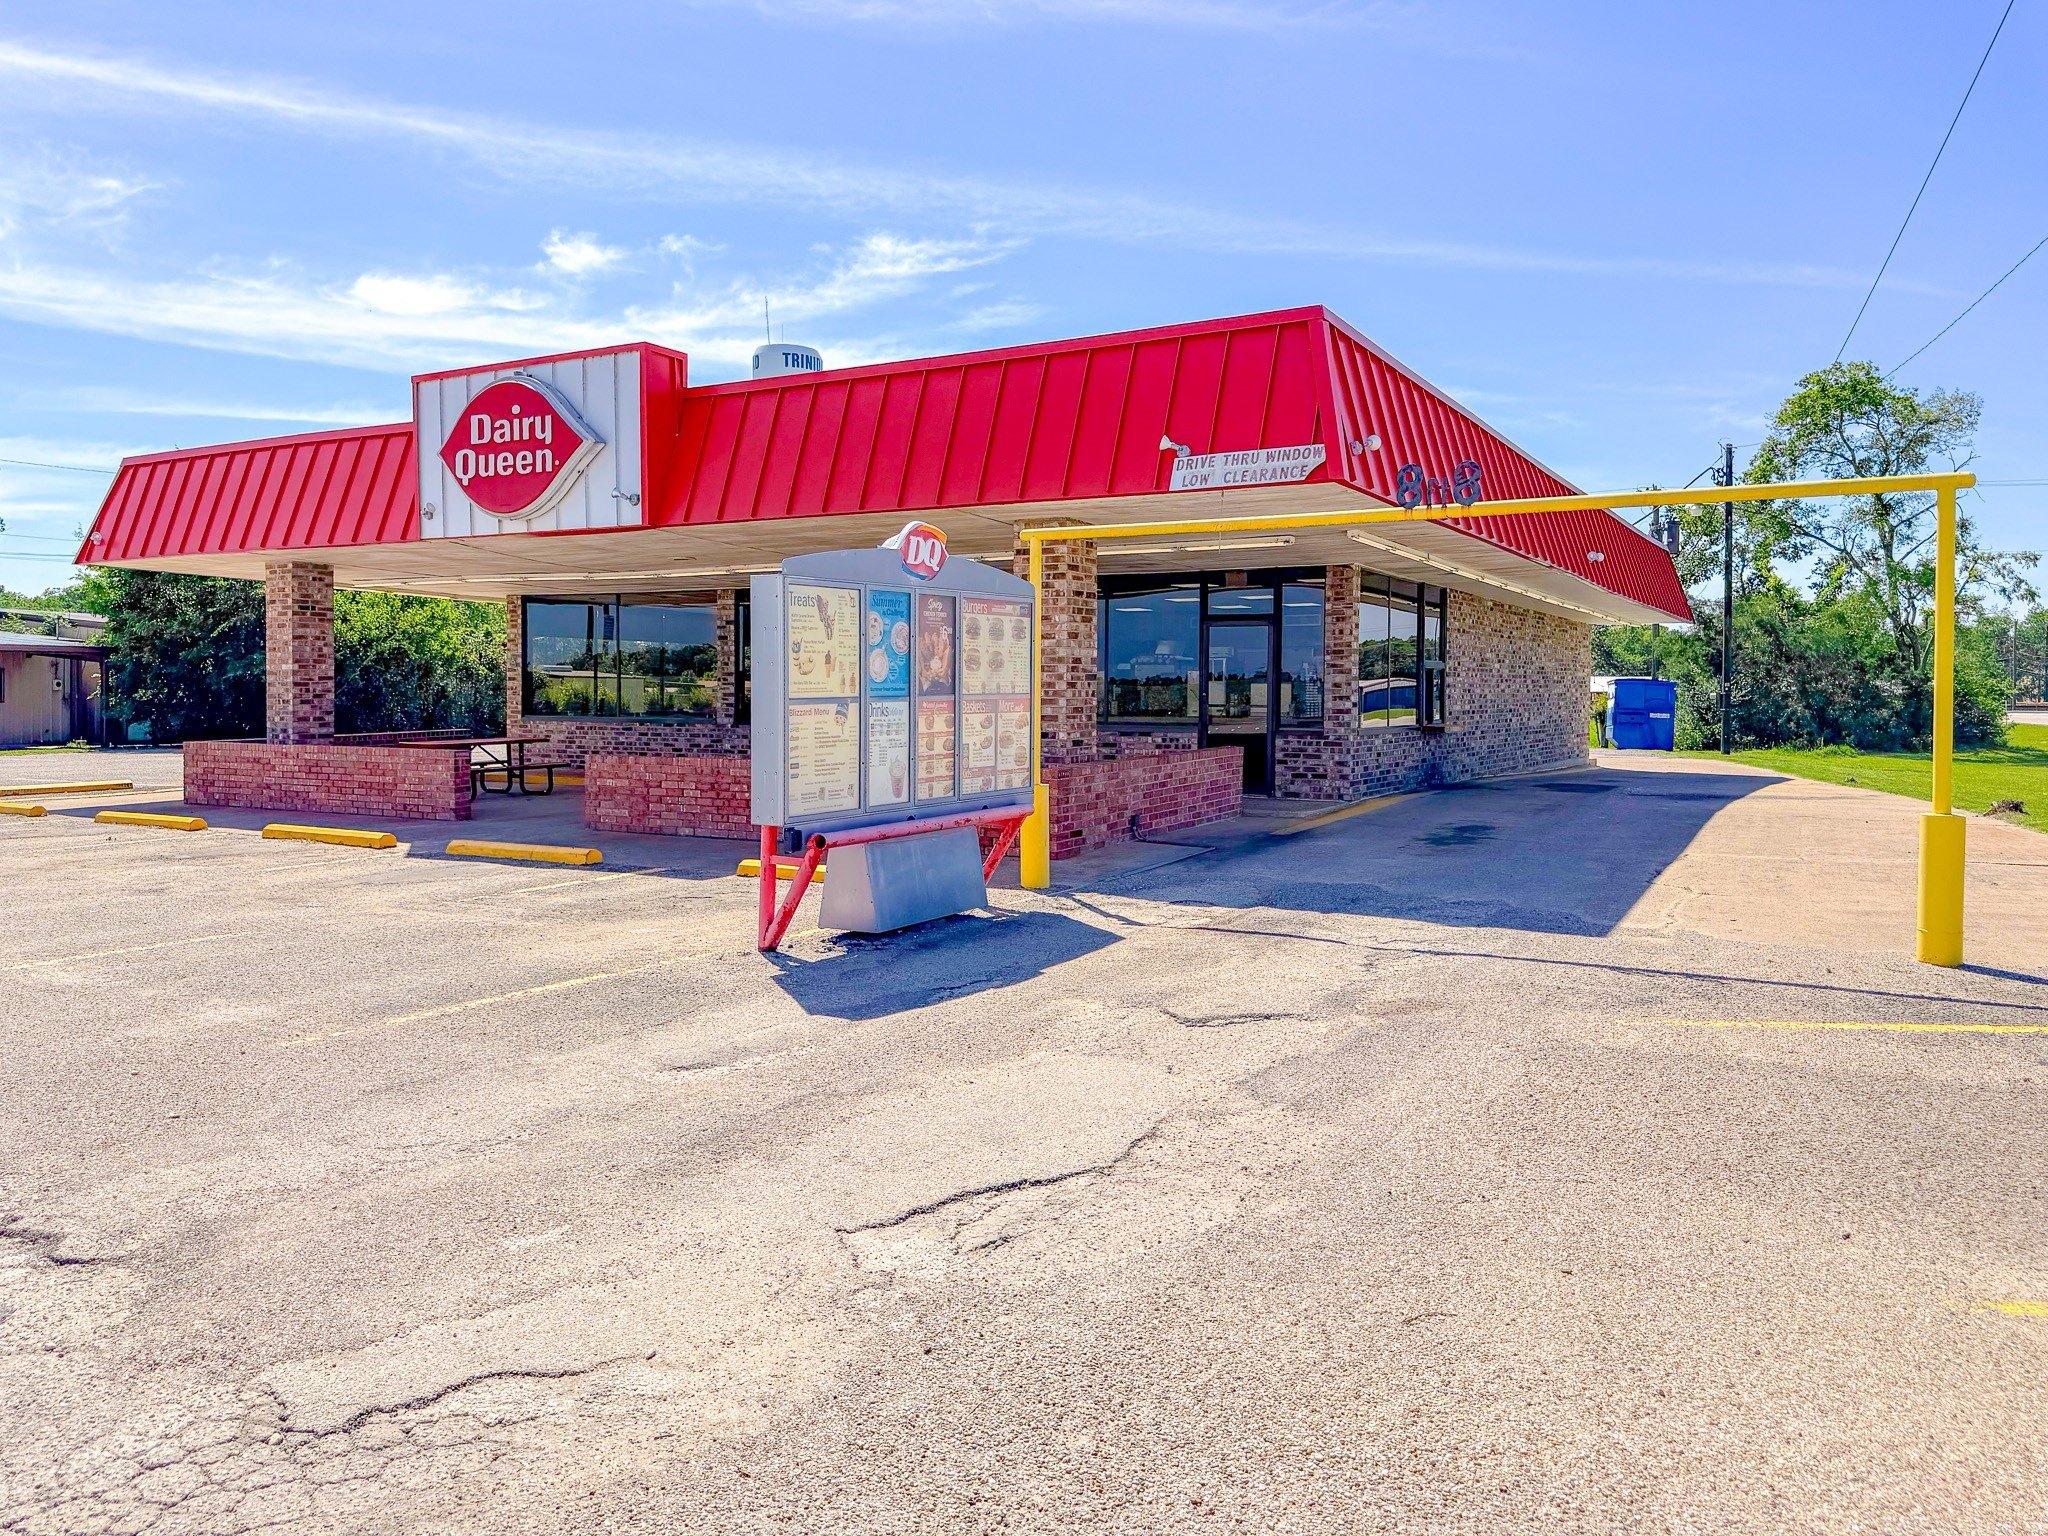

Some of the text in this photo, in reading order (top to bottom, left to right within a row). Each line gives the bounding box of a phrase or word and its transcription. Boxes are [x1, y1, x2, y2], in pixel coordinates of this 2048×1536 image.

[470, 404, 553, 449] Dairy
[1176, 445, 1326, 472] DRIVE THRU WINDOW
[1181, 464, 1309, 488] LOW CLEARANCE
[1396, 463, 1424, 510] 8
[1453, 460, 1483, 506] 8
[908, 534, 944, 572] DQ
[788, 590, 816, 608] Treats
[962, 599, 988, 614] Burgers
[813, 708, 830, 716] Menu
